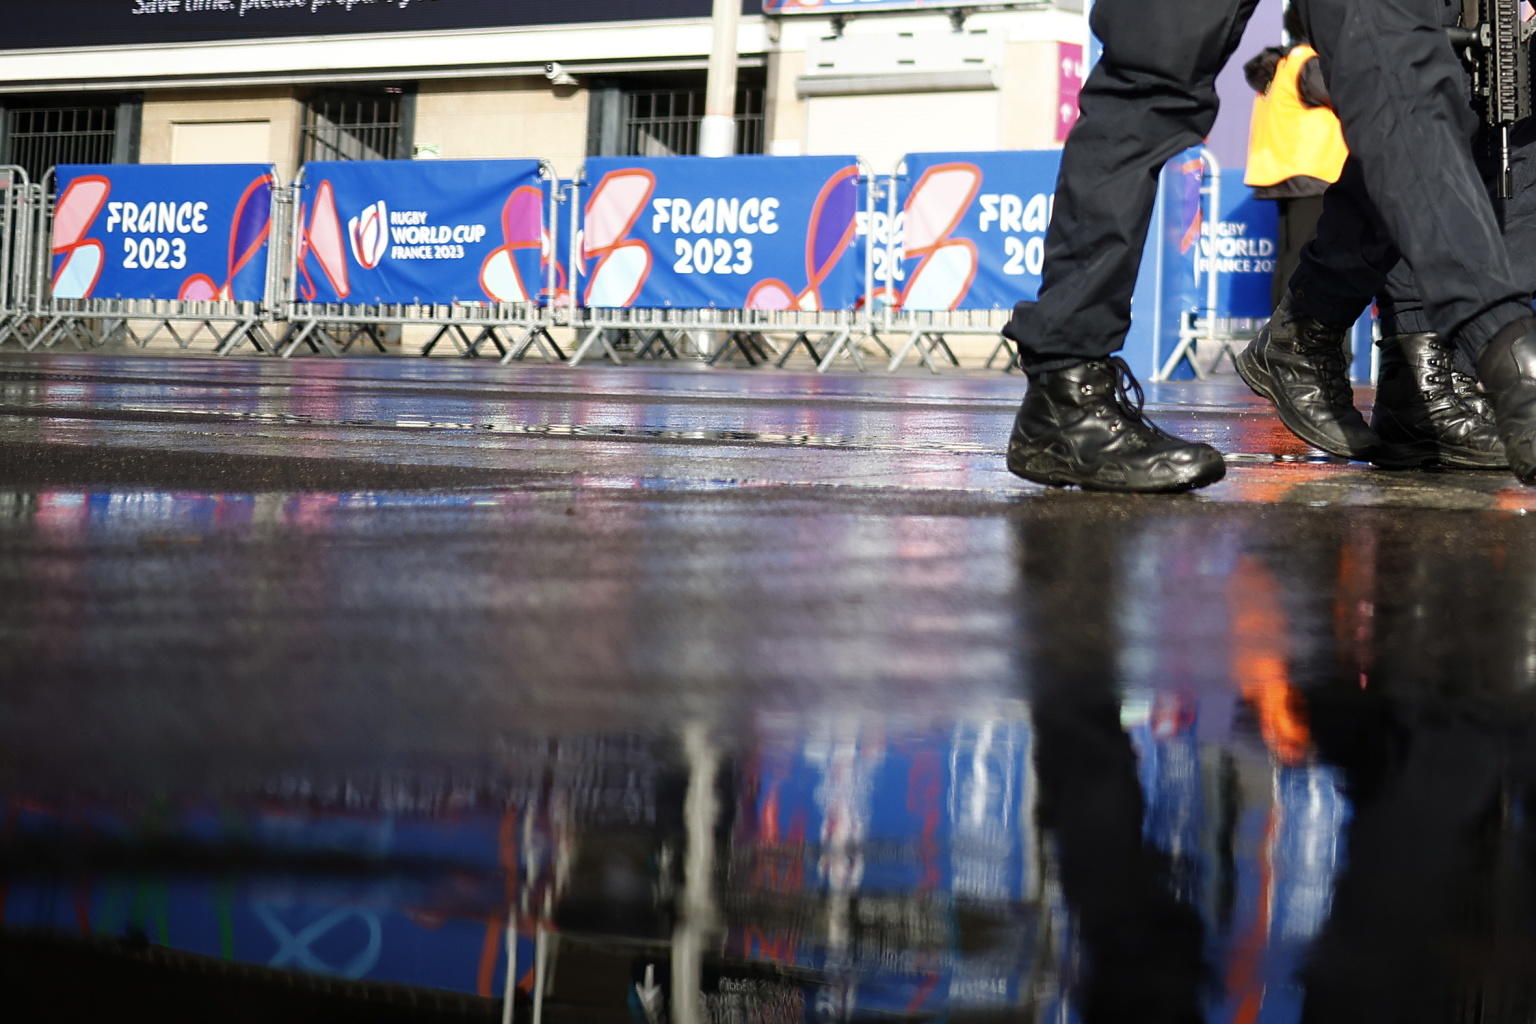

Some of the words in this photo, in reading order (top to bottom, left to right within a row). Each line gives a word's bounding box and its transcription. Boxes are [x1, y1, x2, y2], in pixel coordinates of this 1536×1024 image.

[106, 200, 209, 234] FRANCE
[390, 210, 428, 226] RUGBY
[651, 196, 780, 235] FRANCE
[978, 192, 1055, 233] FRA
[390, 225, 453, 245] WORLD
[453, 223, 487, 244] CUP
[1200, 220, 1247, 237] RGBY
[122, 237, 188, 270] 2023
[391, 245, 433, 260] FRANCE
[434, 244, 465, 259] 2023
[672, 237, 754, 275] 2023
[1200, 237, 1275, 258] WORLD
[1199, 258, 1250, 273] FANCE
